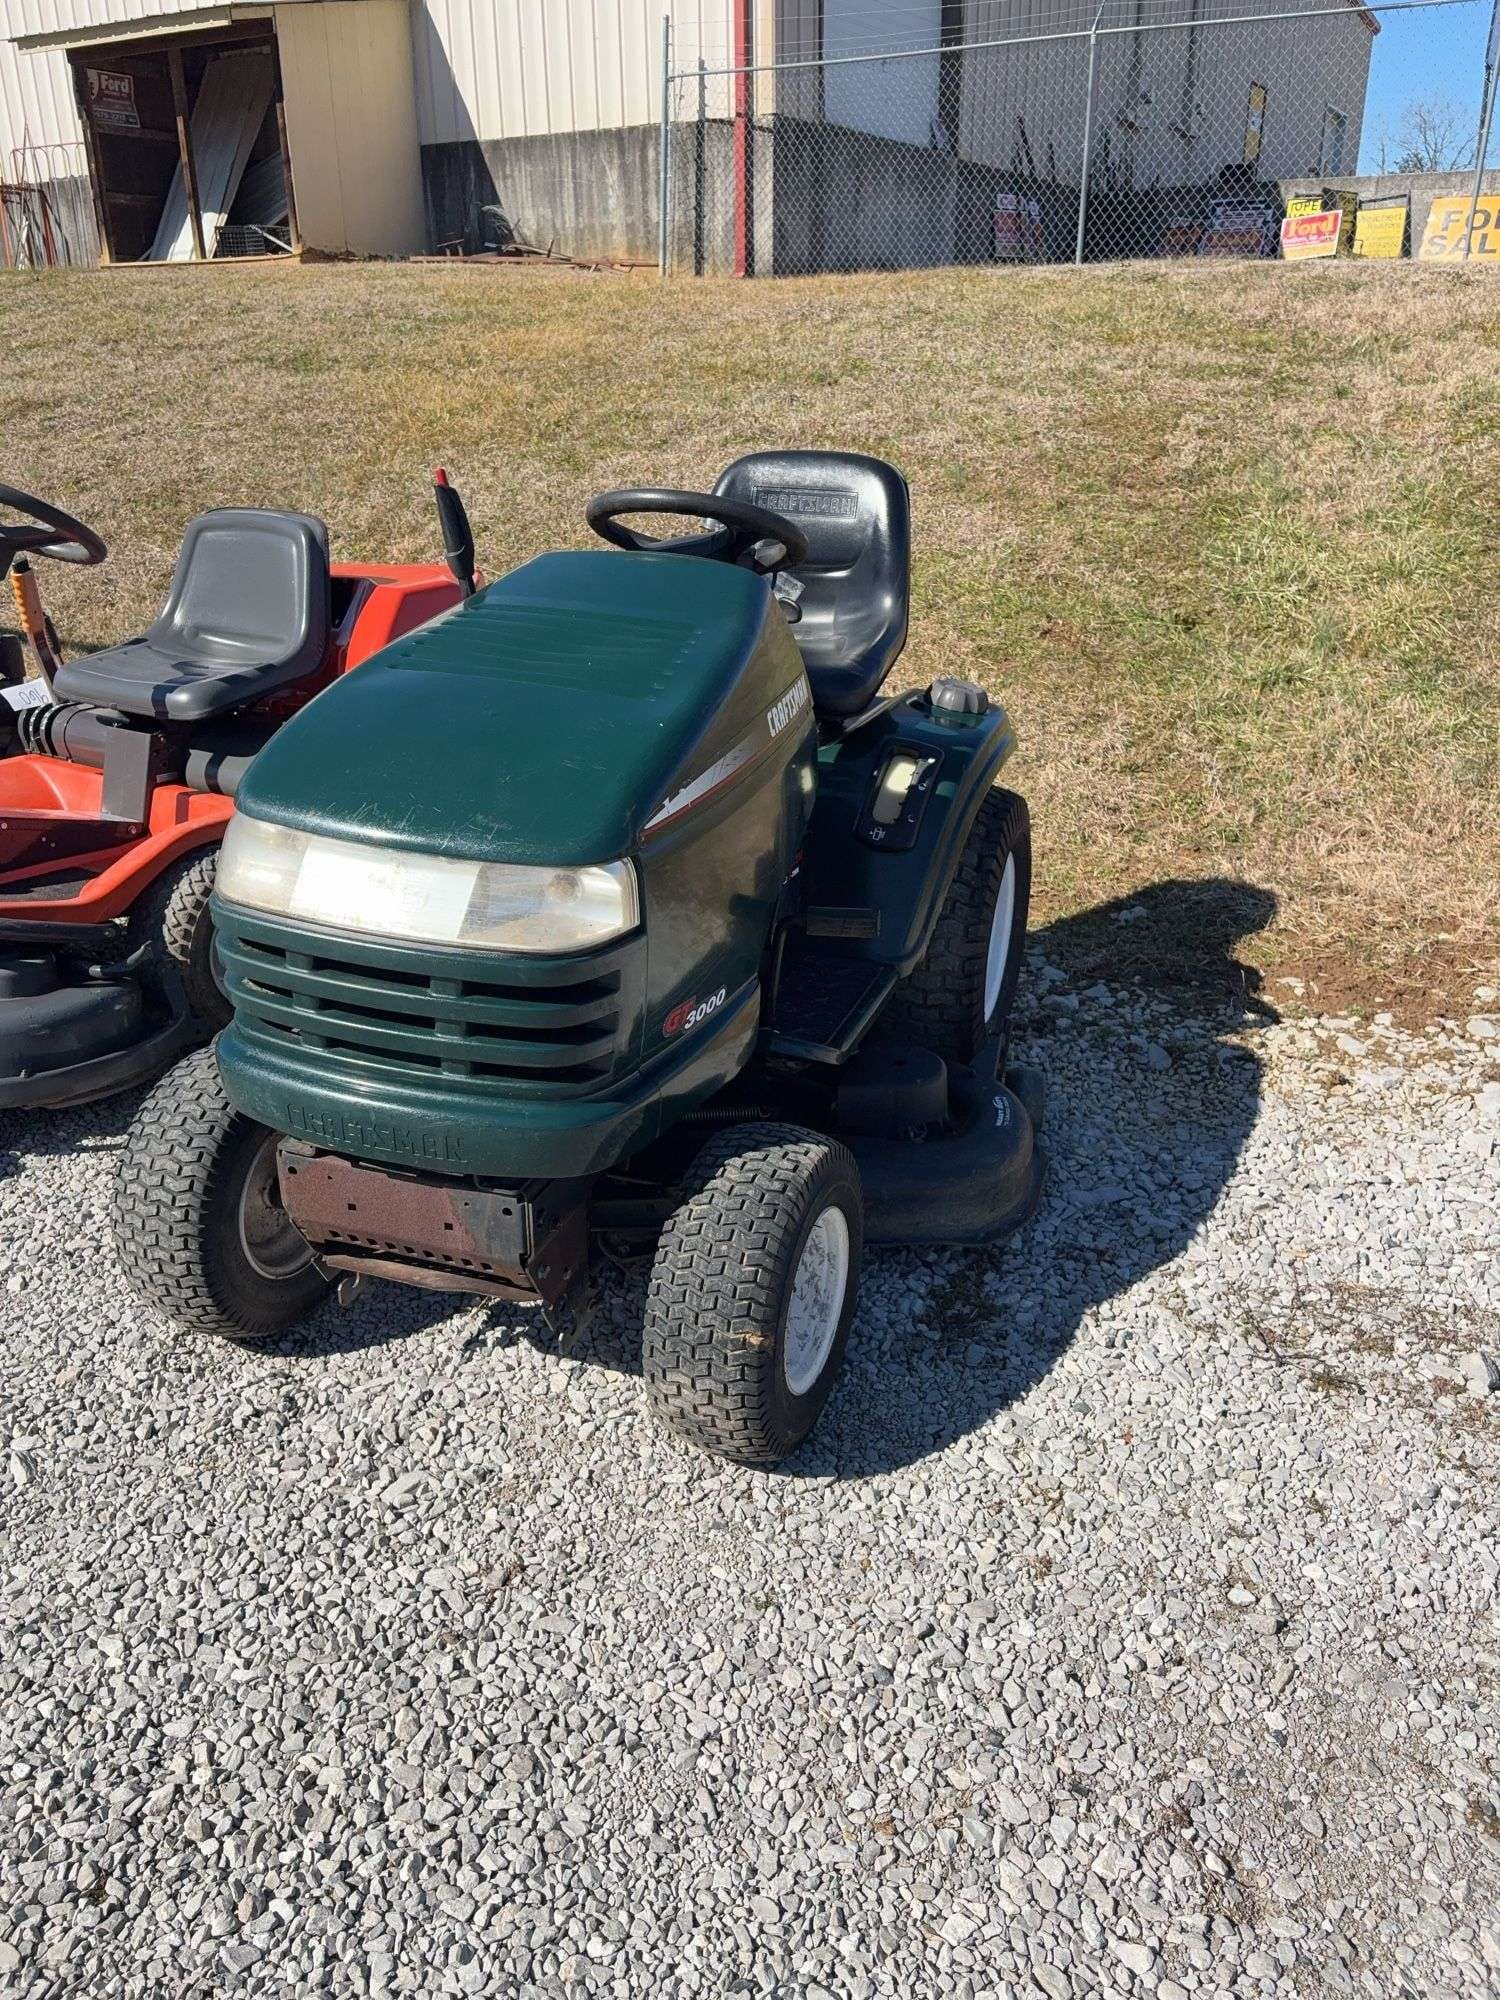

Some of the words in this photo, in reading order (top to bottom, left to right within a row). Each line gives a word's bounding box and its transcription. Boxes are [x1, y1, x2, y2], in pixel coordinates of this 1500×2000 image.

[1441, 209, 1500, 231] FO
[758, 491, 853, 515] CRAFTSMAN
[767, 674, 808, 738] CRAFTSMAN
[684, 988, 726, 1030] 3000
[287, 1103, 472, 1164] CRAFTSMAN
